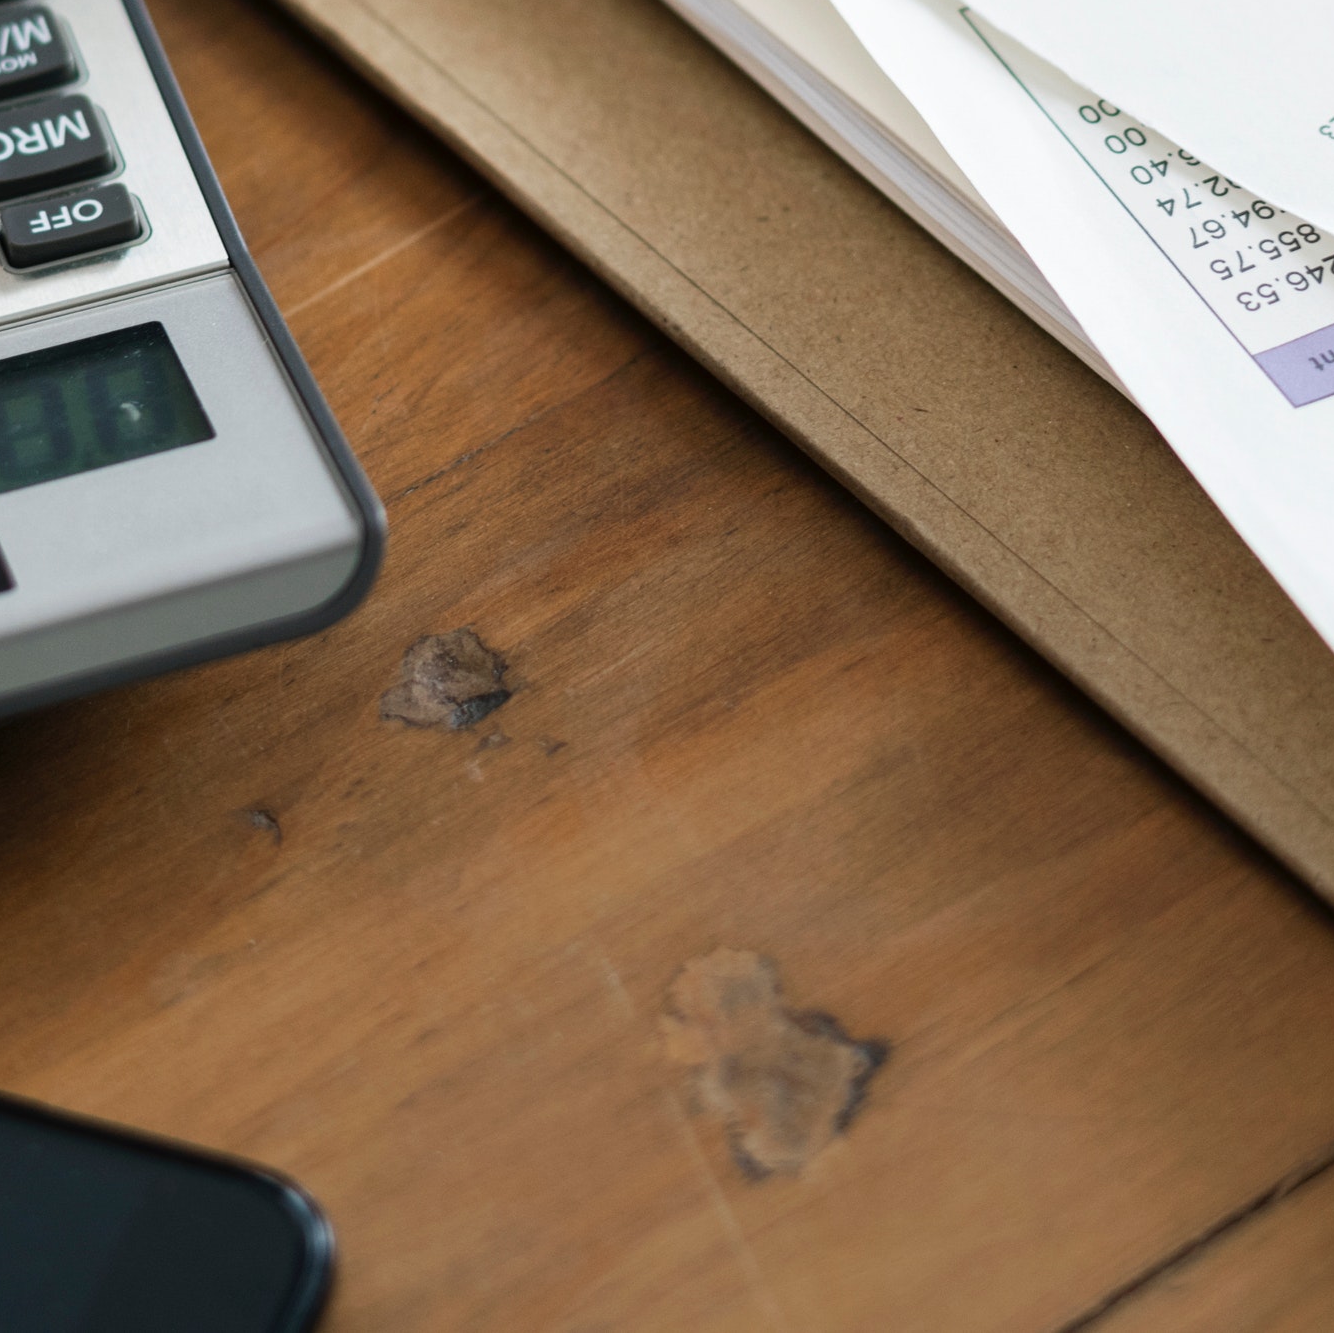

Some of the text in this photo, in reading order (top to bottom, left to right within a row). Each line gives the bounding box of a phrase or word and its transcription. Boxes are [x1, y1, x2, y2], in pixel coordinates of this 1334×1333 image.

[1129, 147, 1202, 186] 6.40
[29, 197, 106, 235] OFF
[1155, 173, 1242, 218] 2.74
[1188, 199, 1289, 250] 94.67
[1209, 223, 1322, 280] 855.75
